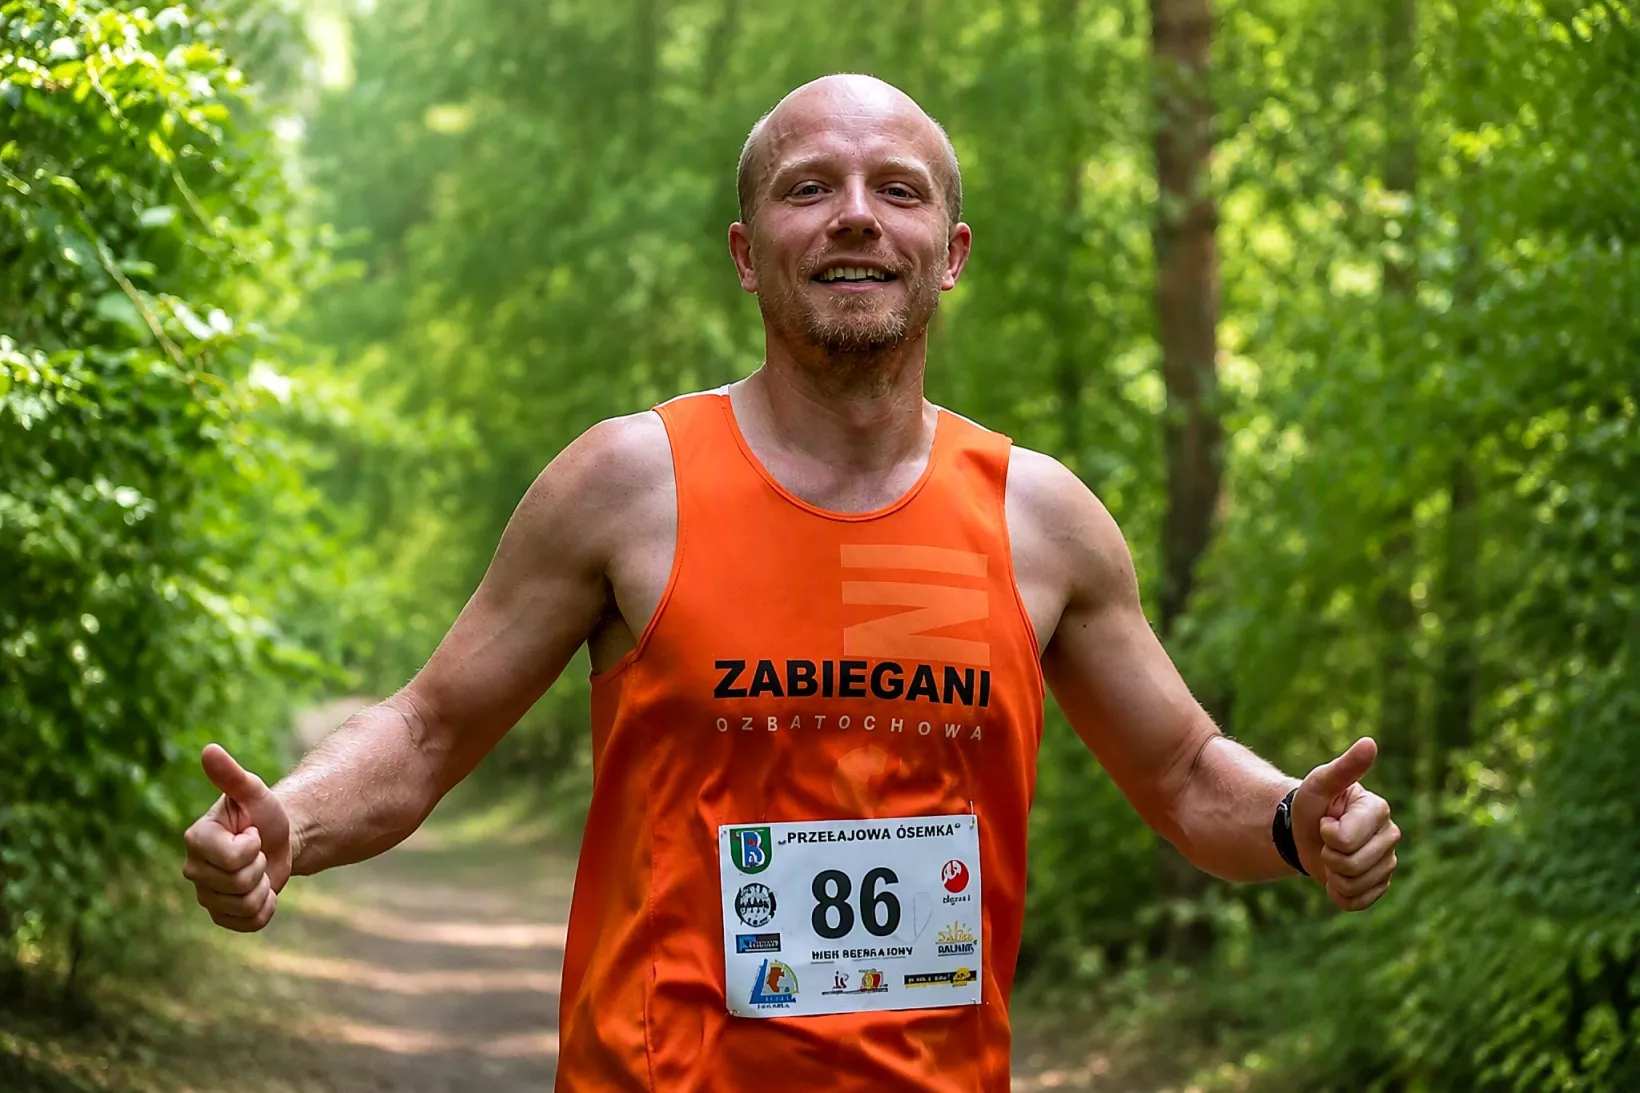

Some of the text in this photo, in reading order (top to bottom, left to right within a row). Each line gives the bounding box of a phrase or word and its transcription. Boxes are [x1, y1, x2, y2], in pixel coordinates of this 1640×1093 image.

[713, 659, 991, 708] ZABIEGANI
[716, 715, 983, 740] OZBATOCHOWA
[811, 866, 902, 939] 86
